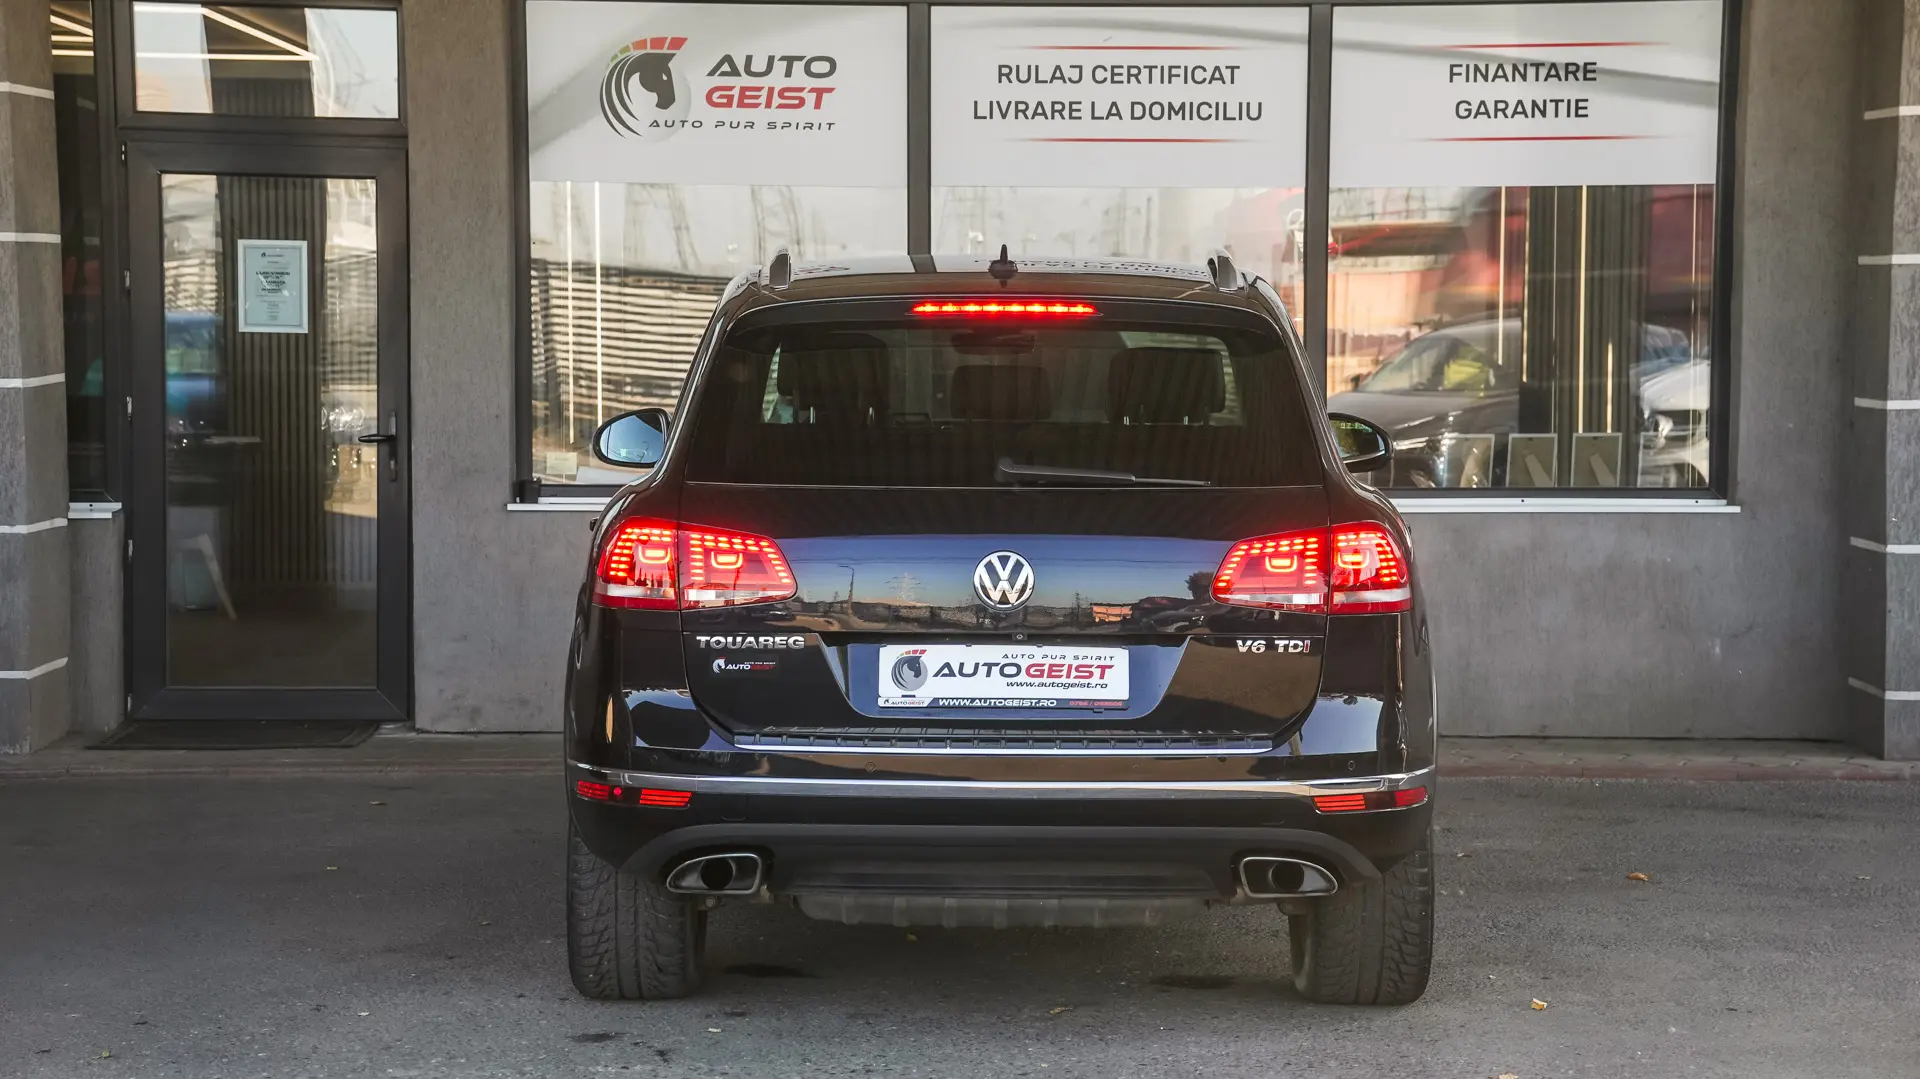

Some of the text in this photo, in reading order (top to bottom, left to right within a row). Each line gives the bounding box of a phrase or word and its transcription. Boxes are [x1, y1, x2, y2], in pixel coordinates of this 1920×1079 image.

[706, 54, 837, 78] AUTO
[998, 65, 1240, 84] RULAJ CERTIFICAT
[1449, 62, 1597, 83] FINANTARE
[705, 86, 836, 110] GEIST
[973, 100, 1263, 121] LIVRARE LA DOMICILIU
[1455, 99, 1589, 119] GARANTIE
[649, 120, 836, 131] AUTO PUR SPIRIT
[696, 636, 805, 649] TOUAREG
[1236, 640, 1311, 653] V6 TDI
[1006, 681, 1108, 690] www.autogeist.ro
[938, 698, 1057, 707] WWW.AUTOGEIST.RO
